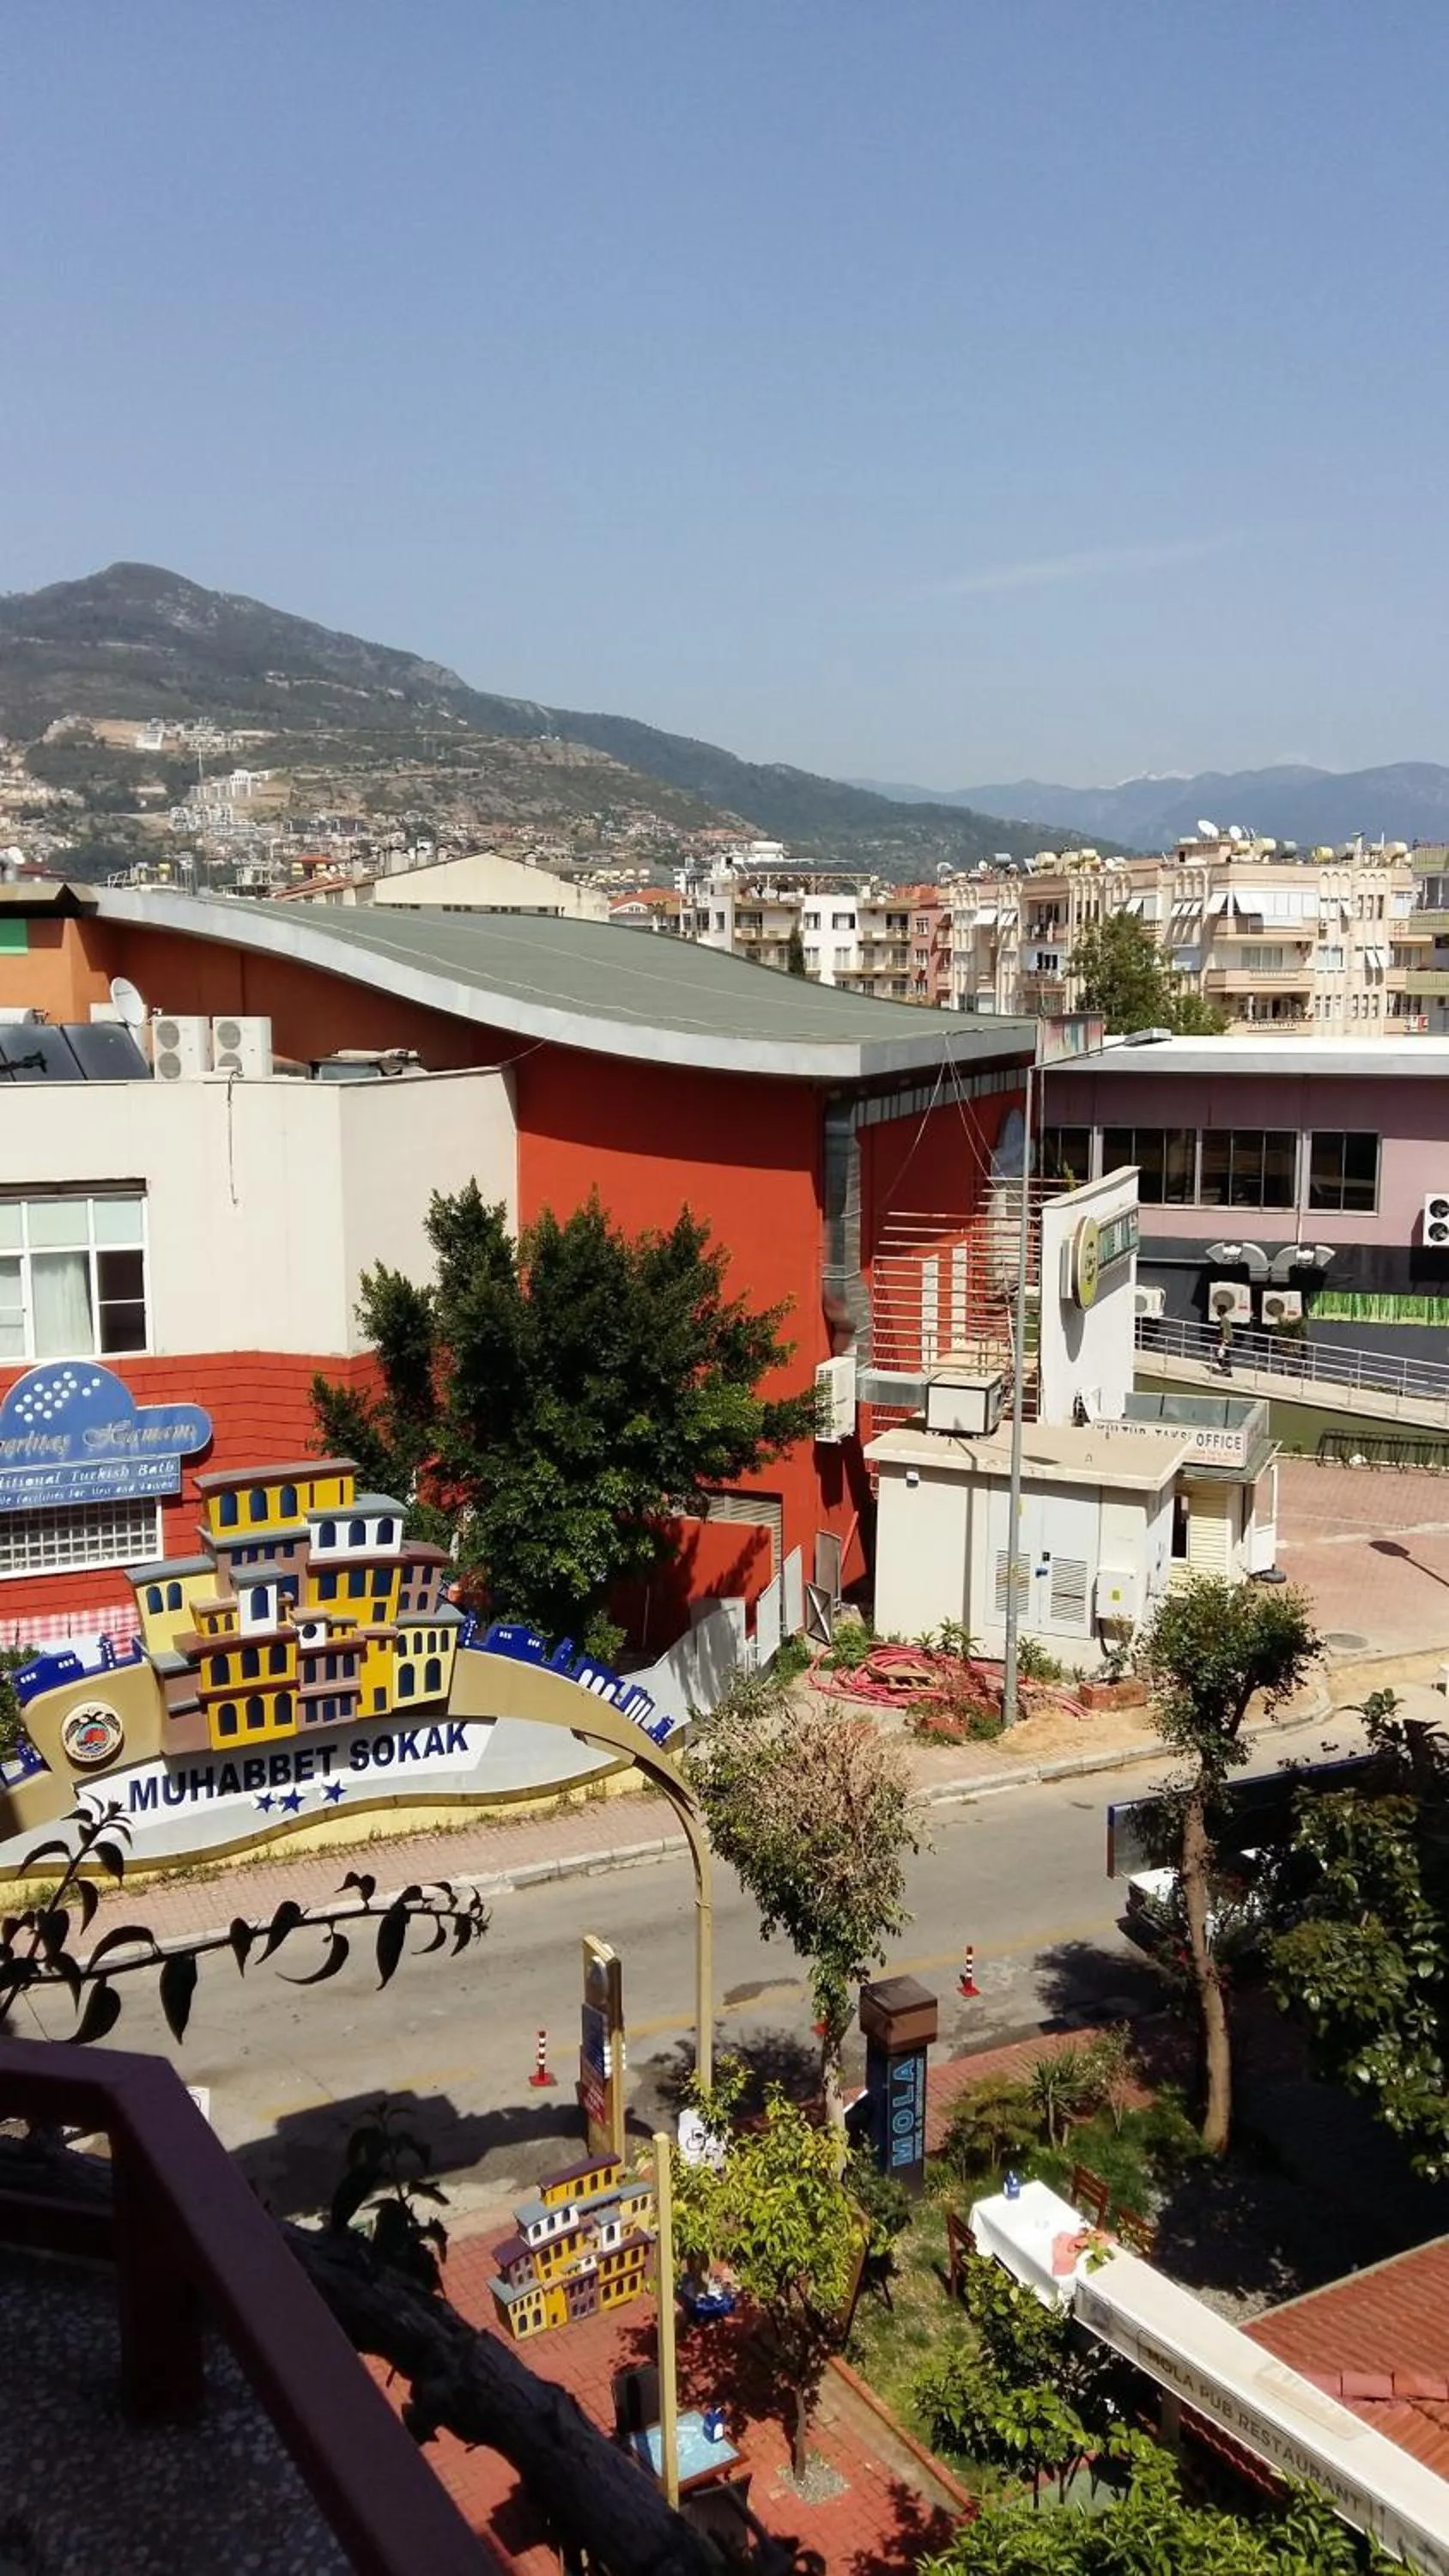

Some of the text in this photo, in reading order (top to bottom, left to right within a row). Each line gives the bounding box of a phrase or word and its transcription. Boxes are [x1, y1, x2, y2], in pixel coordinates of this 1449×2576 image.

[71, 1465, 130, 1483] Turkish
[138, 1461, 174, 1477] Bath
[1196, 1432, 1242, 1450] OFFICE
[129, 1720, 470, 1813] MUHABBET SOKAK
[892, 2059, 915, 2167] MOLA
[1148, 2348, 1194, 2391] MOLA
[1199, 2385, 1234, 2419] PUB
